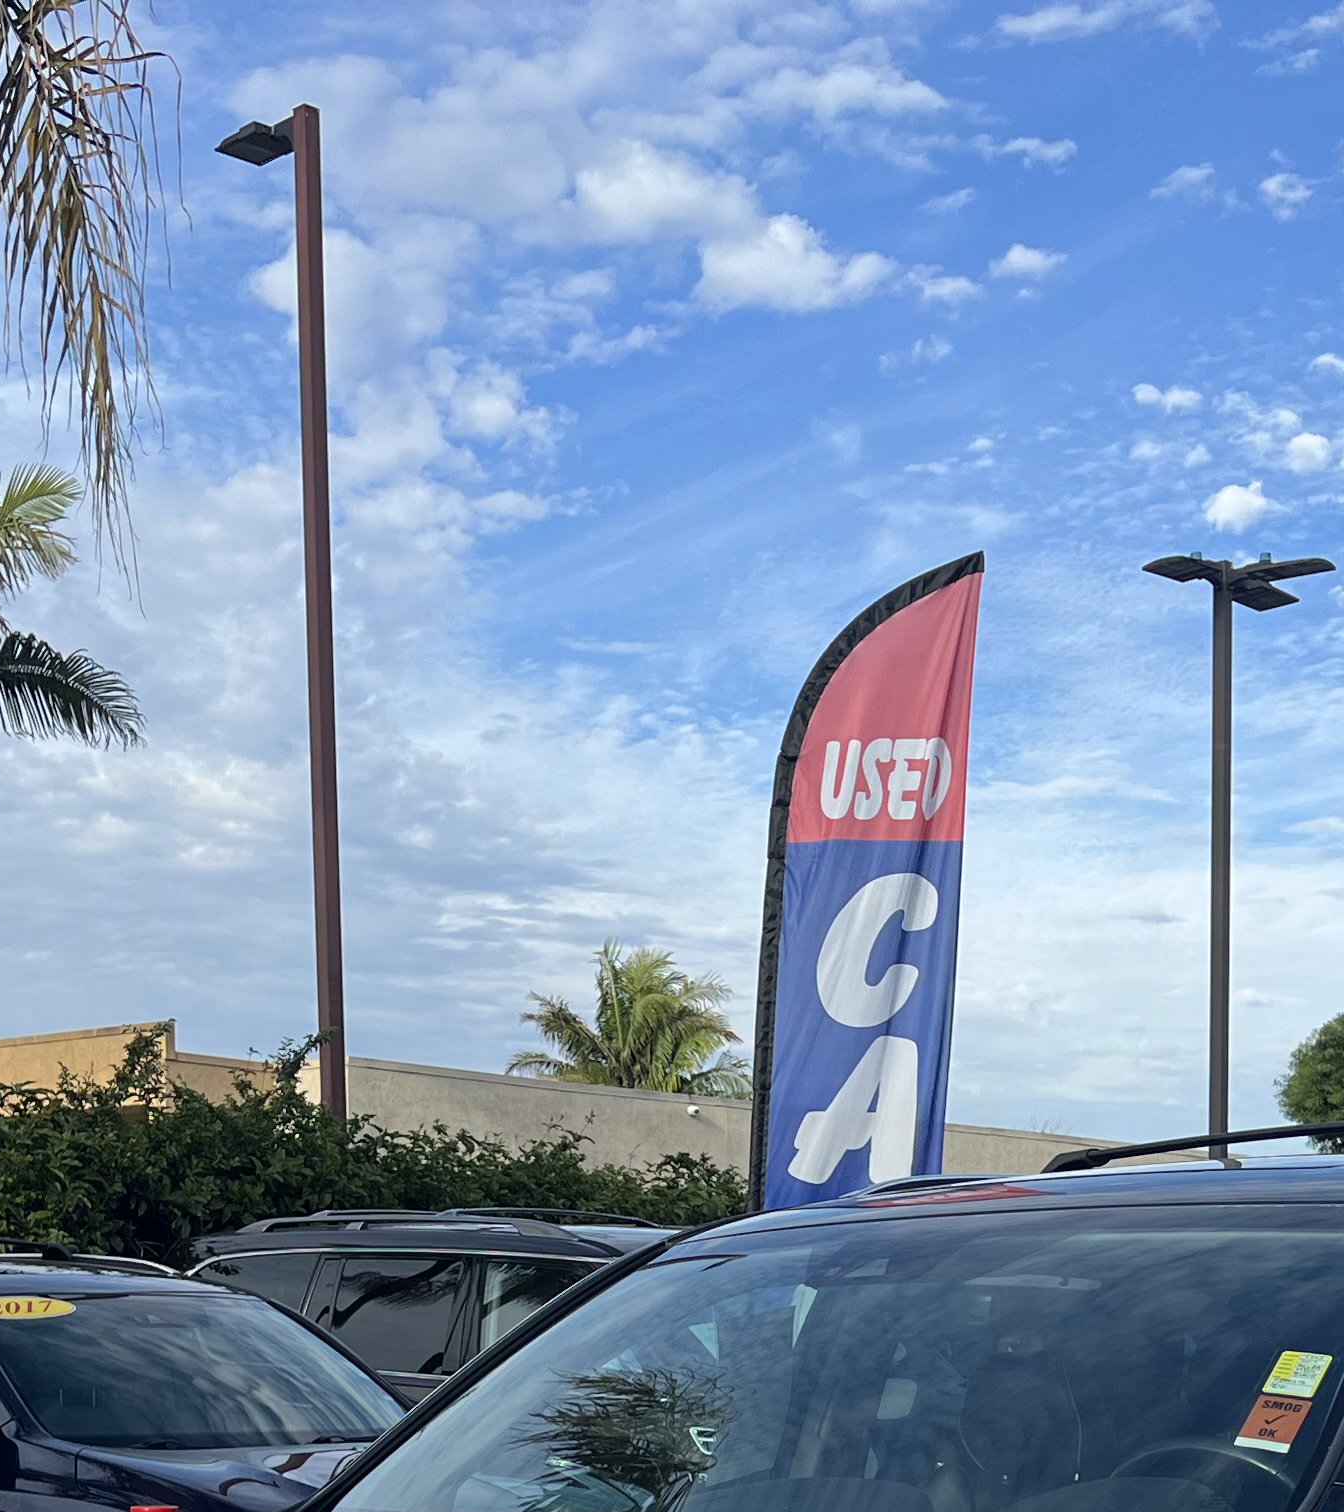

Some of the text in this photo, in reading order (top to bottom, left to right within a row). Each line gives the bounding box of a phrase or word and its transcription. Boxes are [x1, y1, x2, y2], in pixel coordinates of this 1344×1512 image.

[820, 737, 953, 821] USED
[1261, 1400, 1303, 1413] SMOG
[1258, 1427, 1279, 1439] OK
